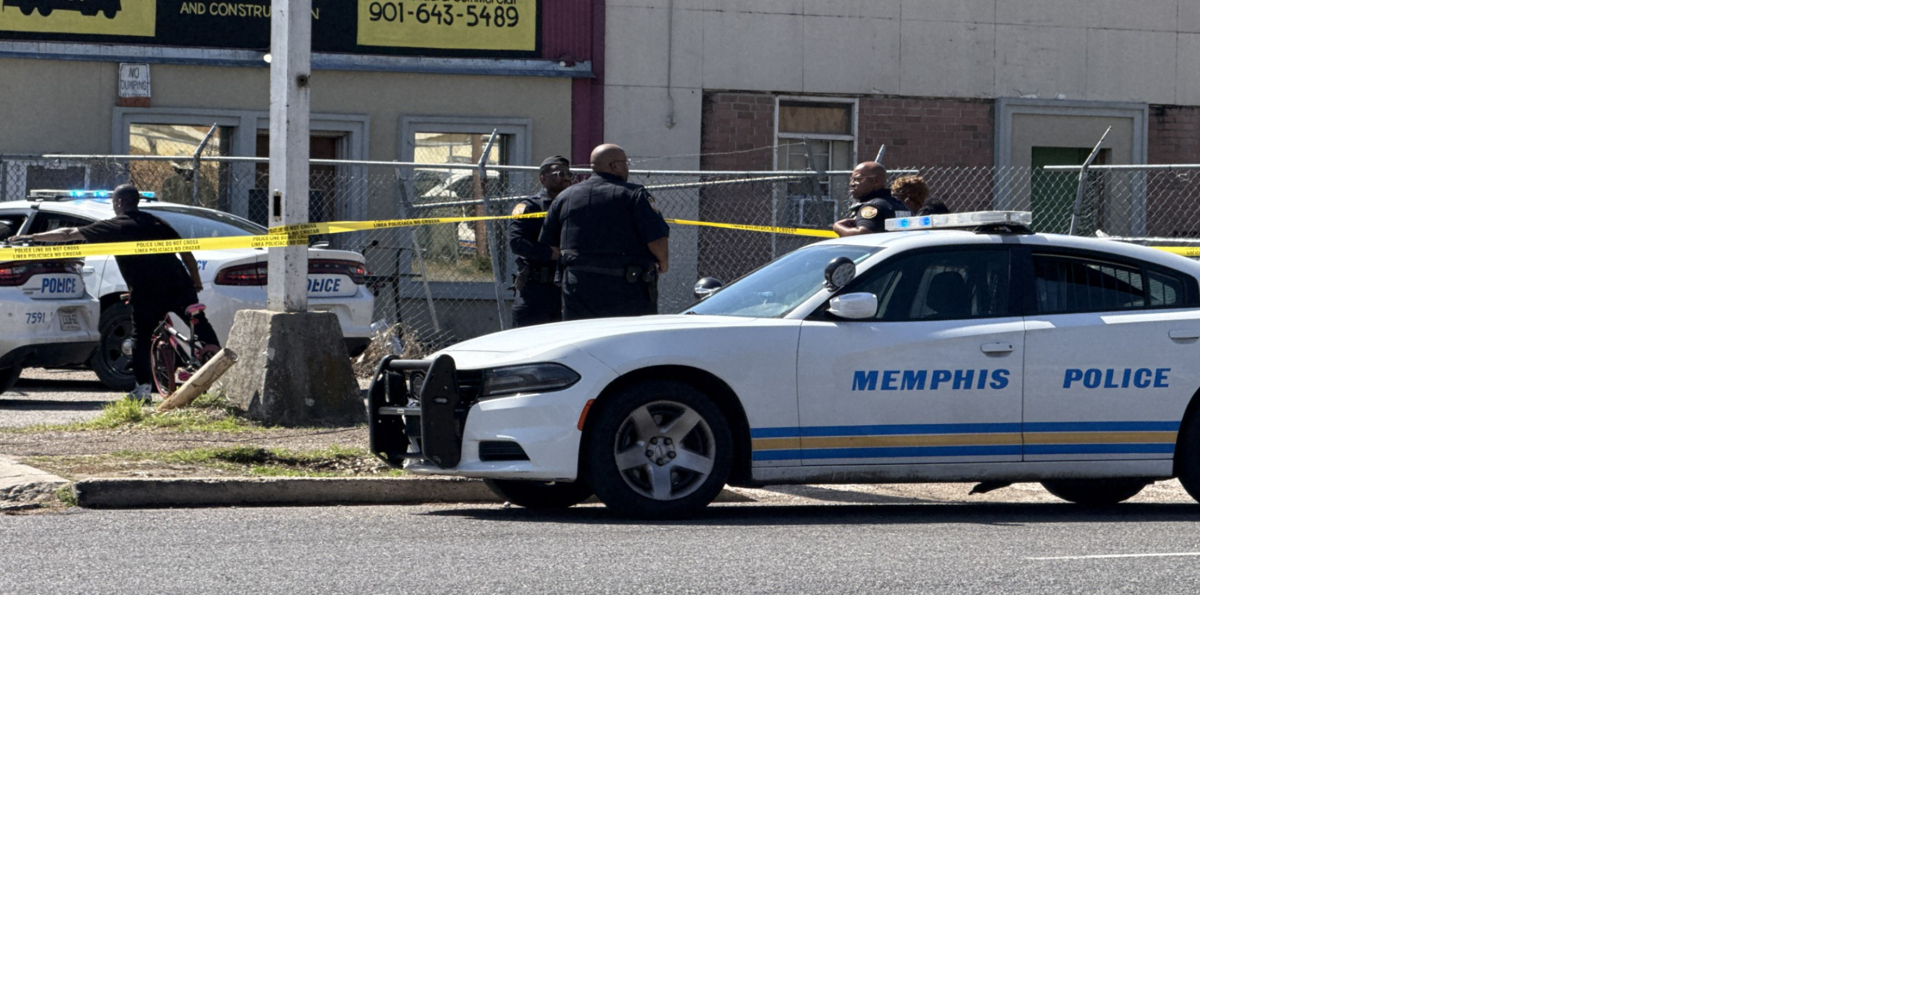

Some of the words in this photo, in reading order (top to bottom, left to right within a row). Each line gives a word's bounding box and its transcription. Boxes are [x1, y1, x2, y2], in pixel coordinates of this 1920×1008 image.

[180, 2, 206, 15] AND
[209, 2, 320, 20] CONSTRUN
[369, 2, 519, 28] 901-643-5489
[129, 66, 140, 79] NO
[120, 80, 147, 90] DUMPING
[41, 278, 77, 293] POLICE
[308, 278, 341, 292] OLICE
[25, 311, 46, 324] 7591
[852, 368, 1010, 391] MEMPHIS
[1062, 368, 1171, 389] POLICE
